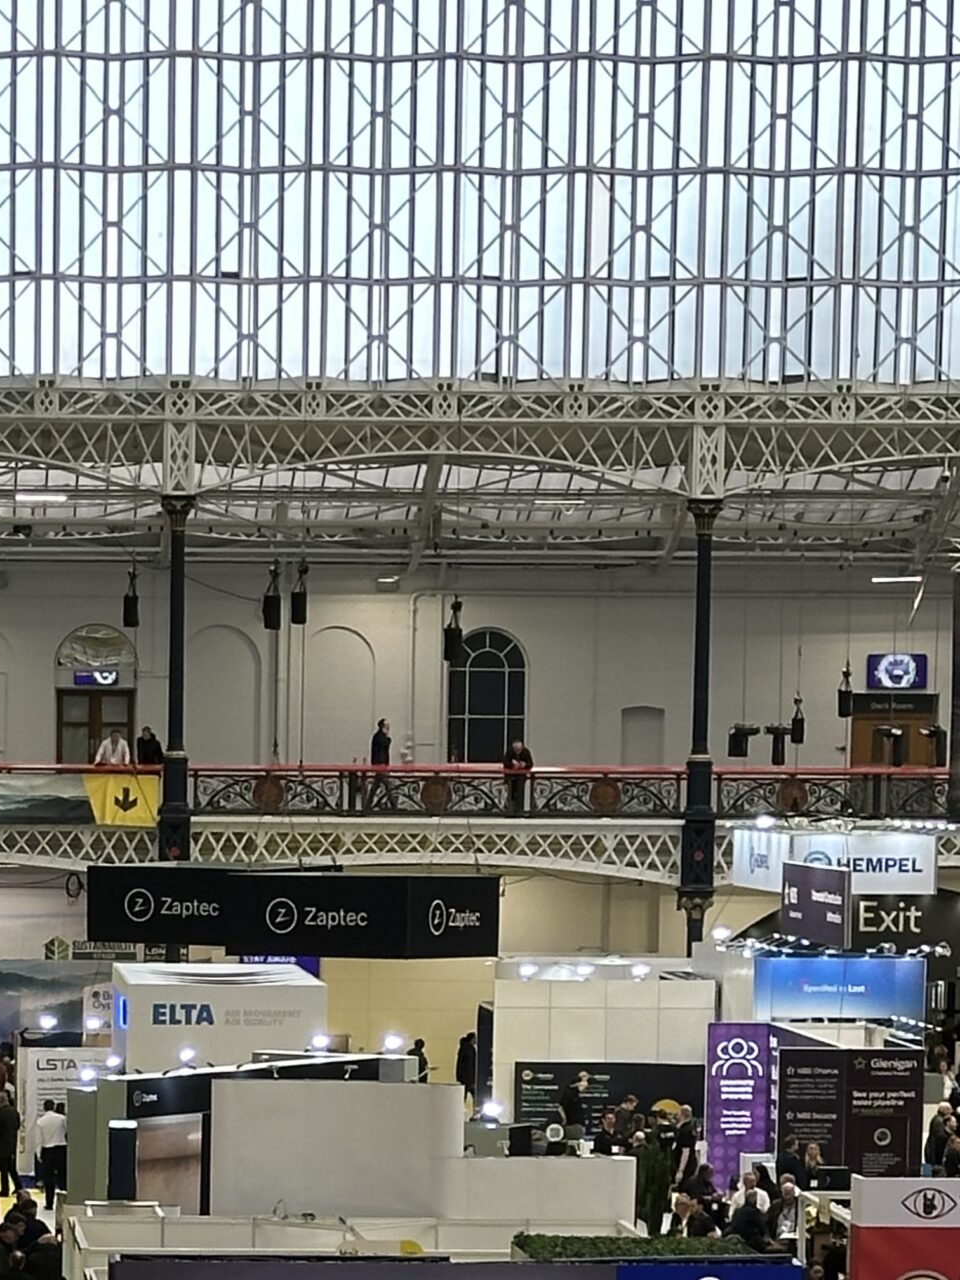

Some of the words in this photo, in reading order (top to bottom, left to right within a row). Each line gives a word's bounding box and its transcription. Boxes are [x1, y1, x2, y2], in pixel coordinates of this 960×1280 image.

[837, 857, 924, 874] HEMPEL
[159, 896, 220, 919] Zaptec
[303, 906, 369, 930] Zaptec
[448, 908, 481, 930] Zaptec
[858, 900, 923, 933] Exit
[152, 1003, 214, 1026] ELTA
